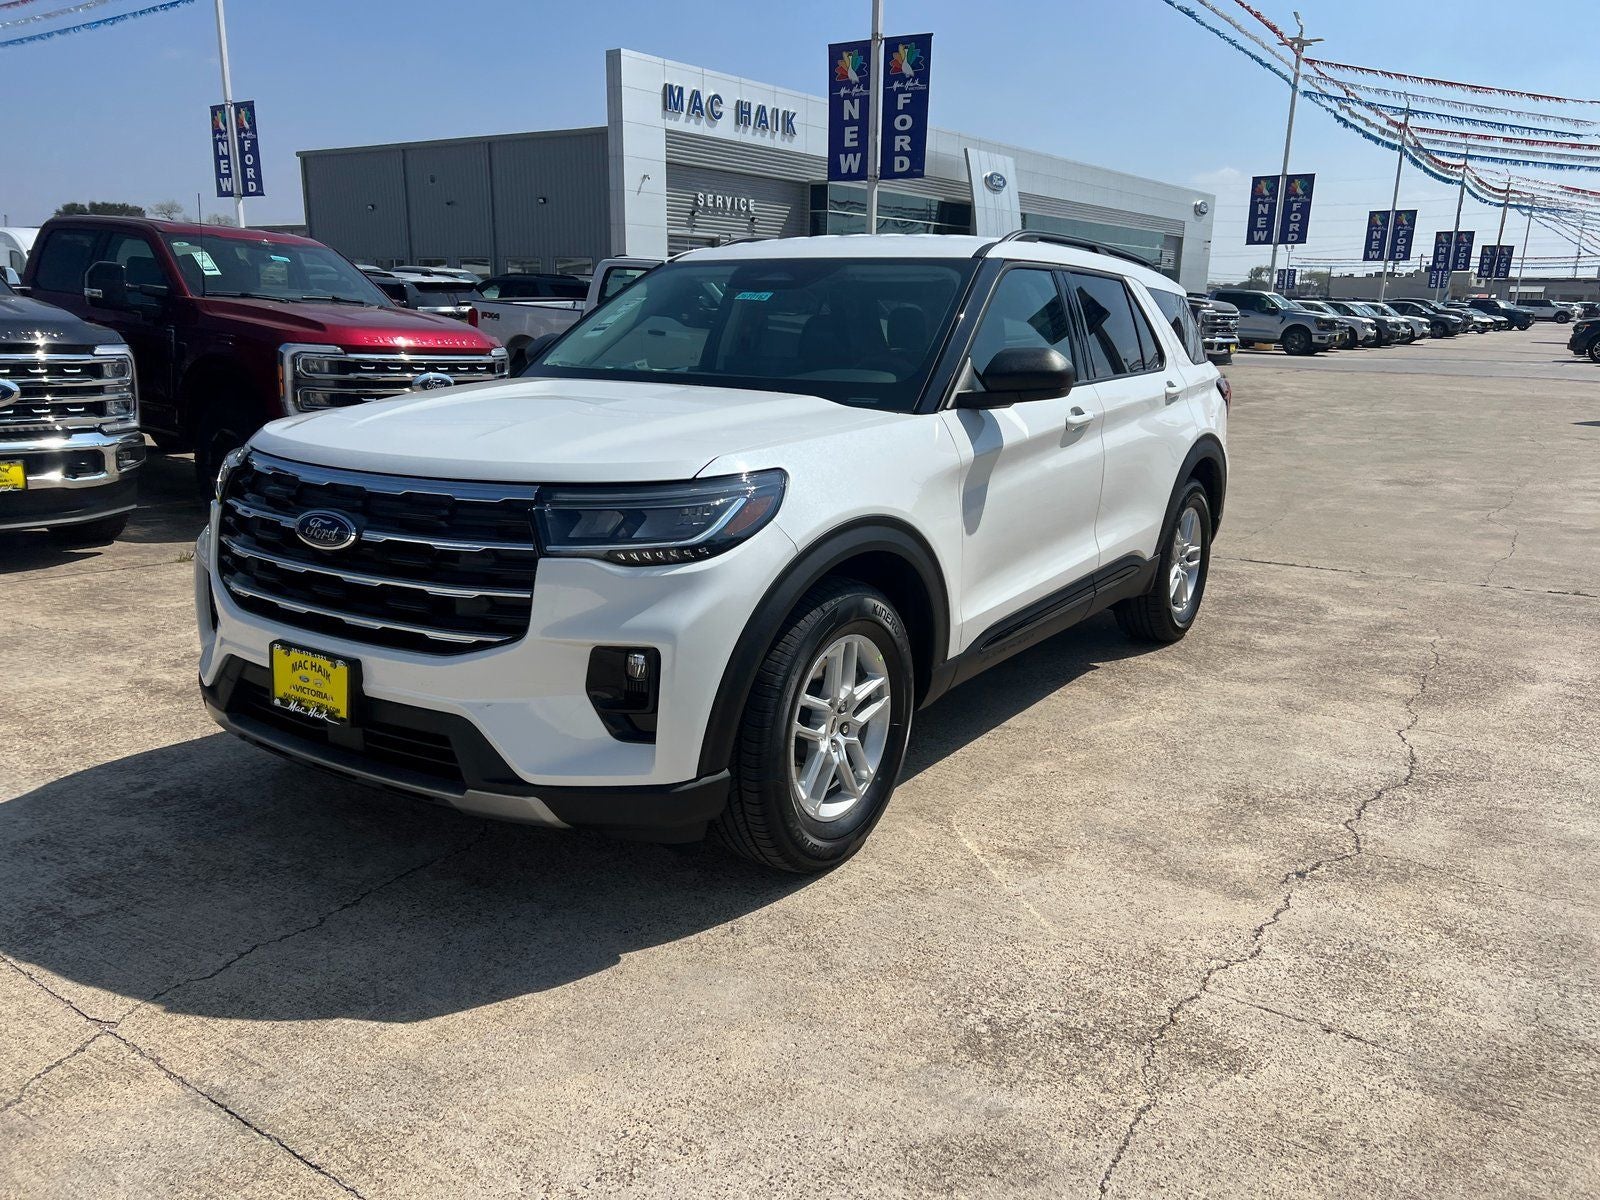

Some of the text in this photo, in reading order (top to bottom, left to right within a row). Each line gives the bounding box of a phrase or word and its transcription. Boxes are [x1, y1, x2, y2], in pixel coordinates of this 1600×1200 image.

[662, 83, 797, 136] MAC HAIK
[839, 98, 861, 174] NEW
[894, 92, 913, 173] FORD
[218, 141, 233, 192] NEW
[244, 140, 257, 193] FORD
[697, 191, 756, 212] SERVICE
[1253, 203, 1270, 242] NEW
[1287, 202, 1302, 242] FORD
[1368, 230, 1381, 259] NEW
[1395, 230, 1407, 260] FORD
[1436, 246, 1447, 270] NEW
[1457, 246, 1467, 270] FORD
[1481, 257, 1490, 277] NEW
[481, 311, 500, 320] FX4
[305, 517, 339, 541] Ford
[292, 660, 308, 674] MAC
[310, 661, 331, 684] HAIK
[294, 684, 330, 701] VICTORIA
[287, 700, 307, 715] Mac
